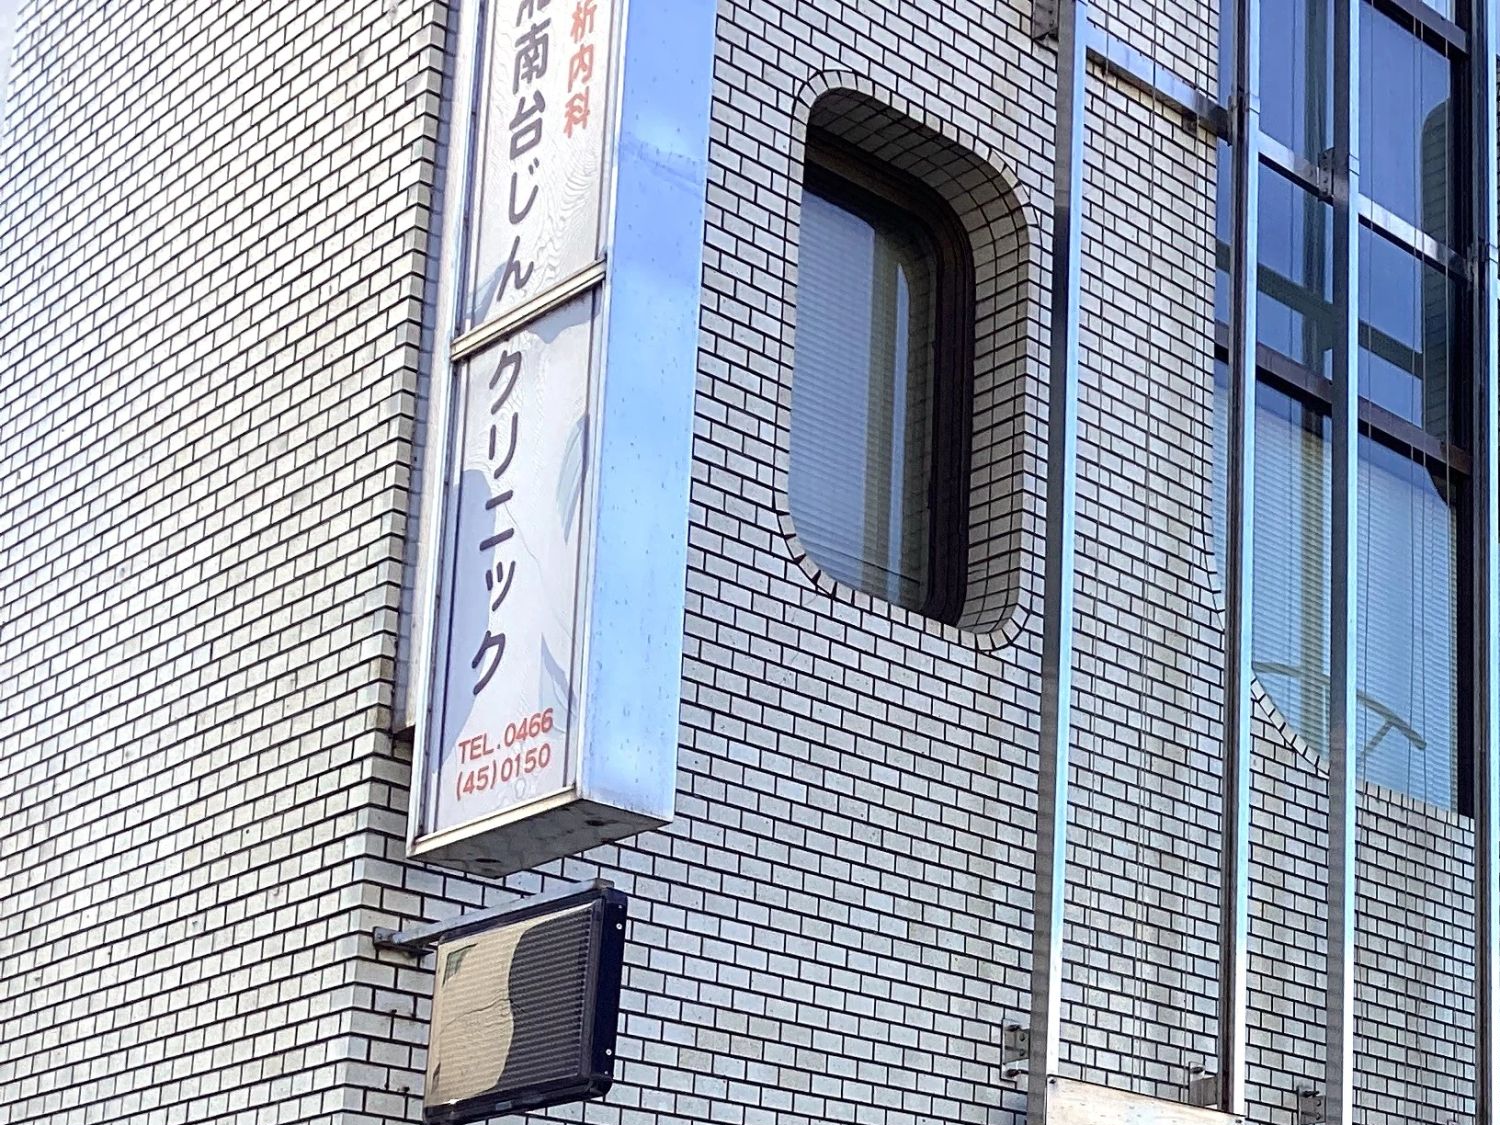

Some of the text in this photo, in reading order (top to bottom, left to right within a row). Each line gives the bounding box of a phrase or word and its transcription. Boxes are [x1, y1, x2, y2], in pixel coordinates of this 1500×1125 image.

[471, 349, 522, 696] クリニック
[458, 708, 554, 764] TEL.0466
[456, 743, 551, 800] (45)0150
